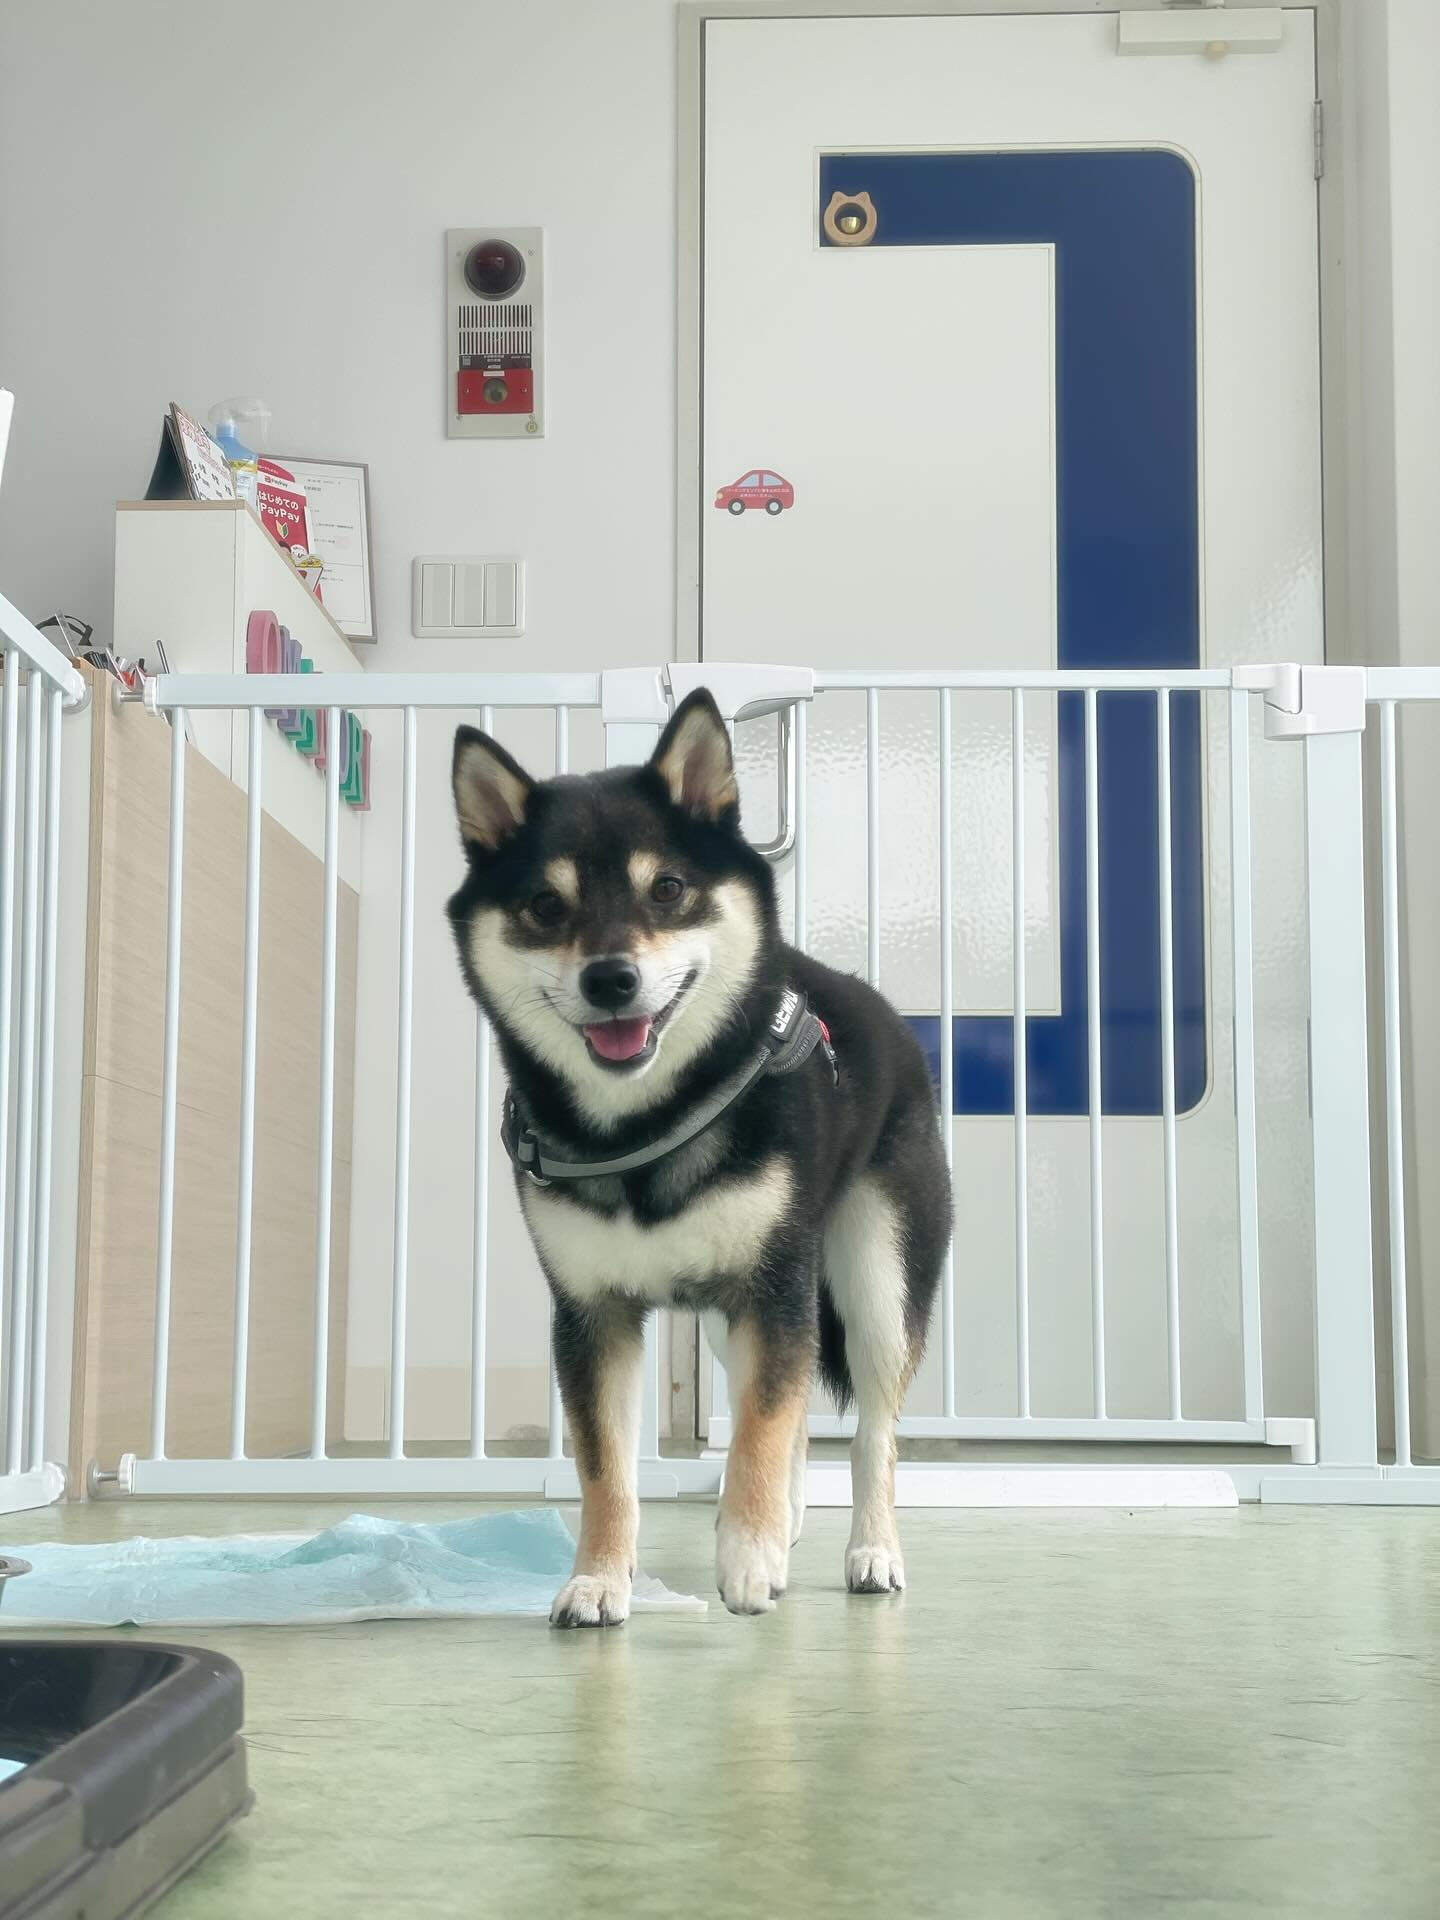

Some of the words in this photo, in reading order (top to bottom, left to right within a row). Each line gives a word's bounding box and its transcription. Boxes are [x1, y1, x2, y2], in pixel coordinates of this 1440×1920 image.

[259, 491, 299, 511] はじめての
[260, 503, 300, 523] PayPay
